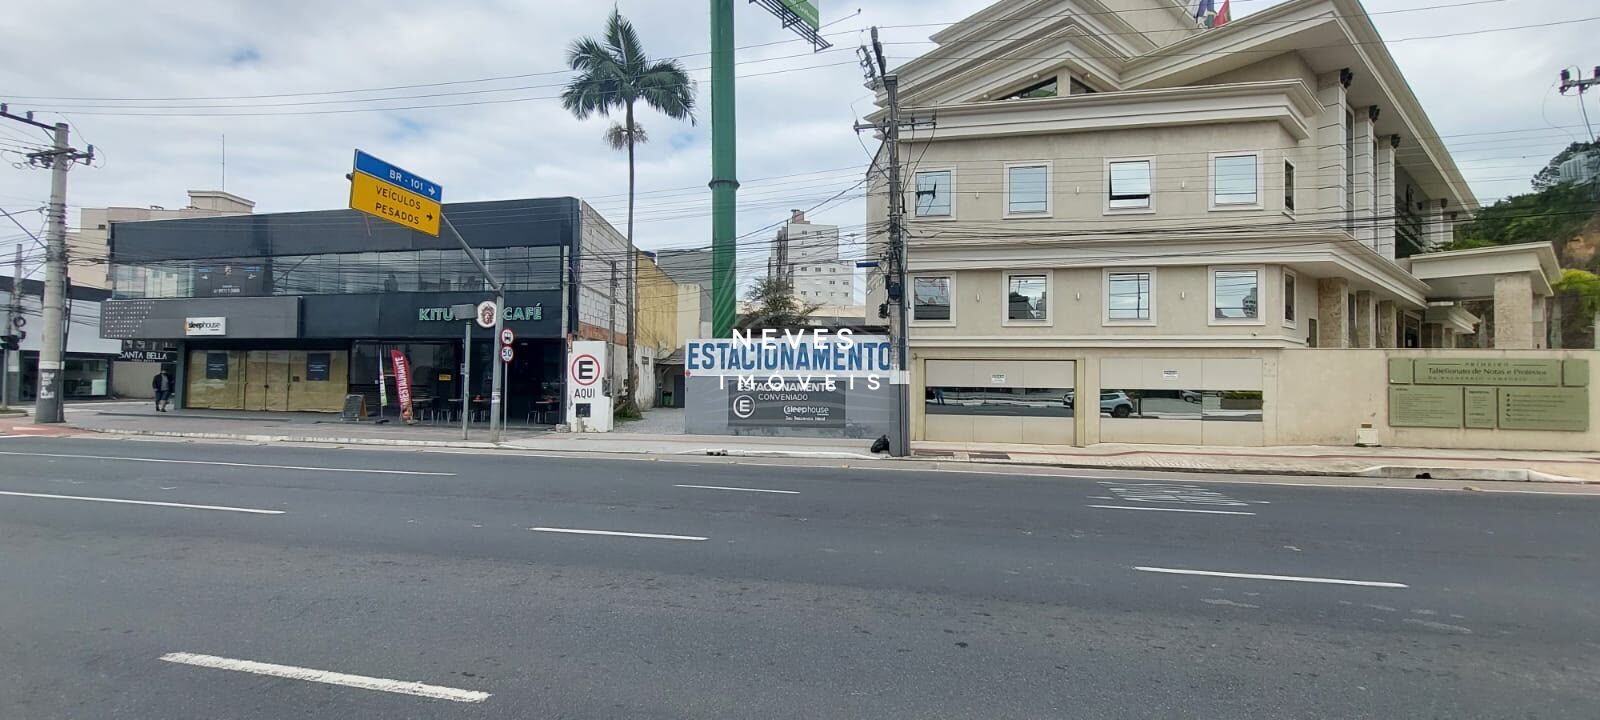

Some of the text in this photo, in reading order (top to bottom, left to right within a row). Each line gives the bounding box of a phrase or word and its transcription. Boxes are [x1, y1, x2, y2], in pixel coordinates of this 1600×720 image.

[389, 169, 402, 182] BR
[410, 178, 424, 191] 101
[375, 185, 421, 210] VEÍCULOS
[375, 202, 420, 225] PESADOS
[503, 302, 542, 320] CAFÉ
[119, 351, 168, 360] SANTA BELLA
[503, 348, 513, 358] 50
[687, 342, 891, 371] ESTACIONAMENTO
[578, 360, 593, 380] E
[1483, 368, 1505, 376] Notas
[574, 387, 596, 399] AQUI
[758, 393, 809, 401] CONVENIADO
